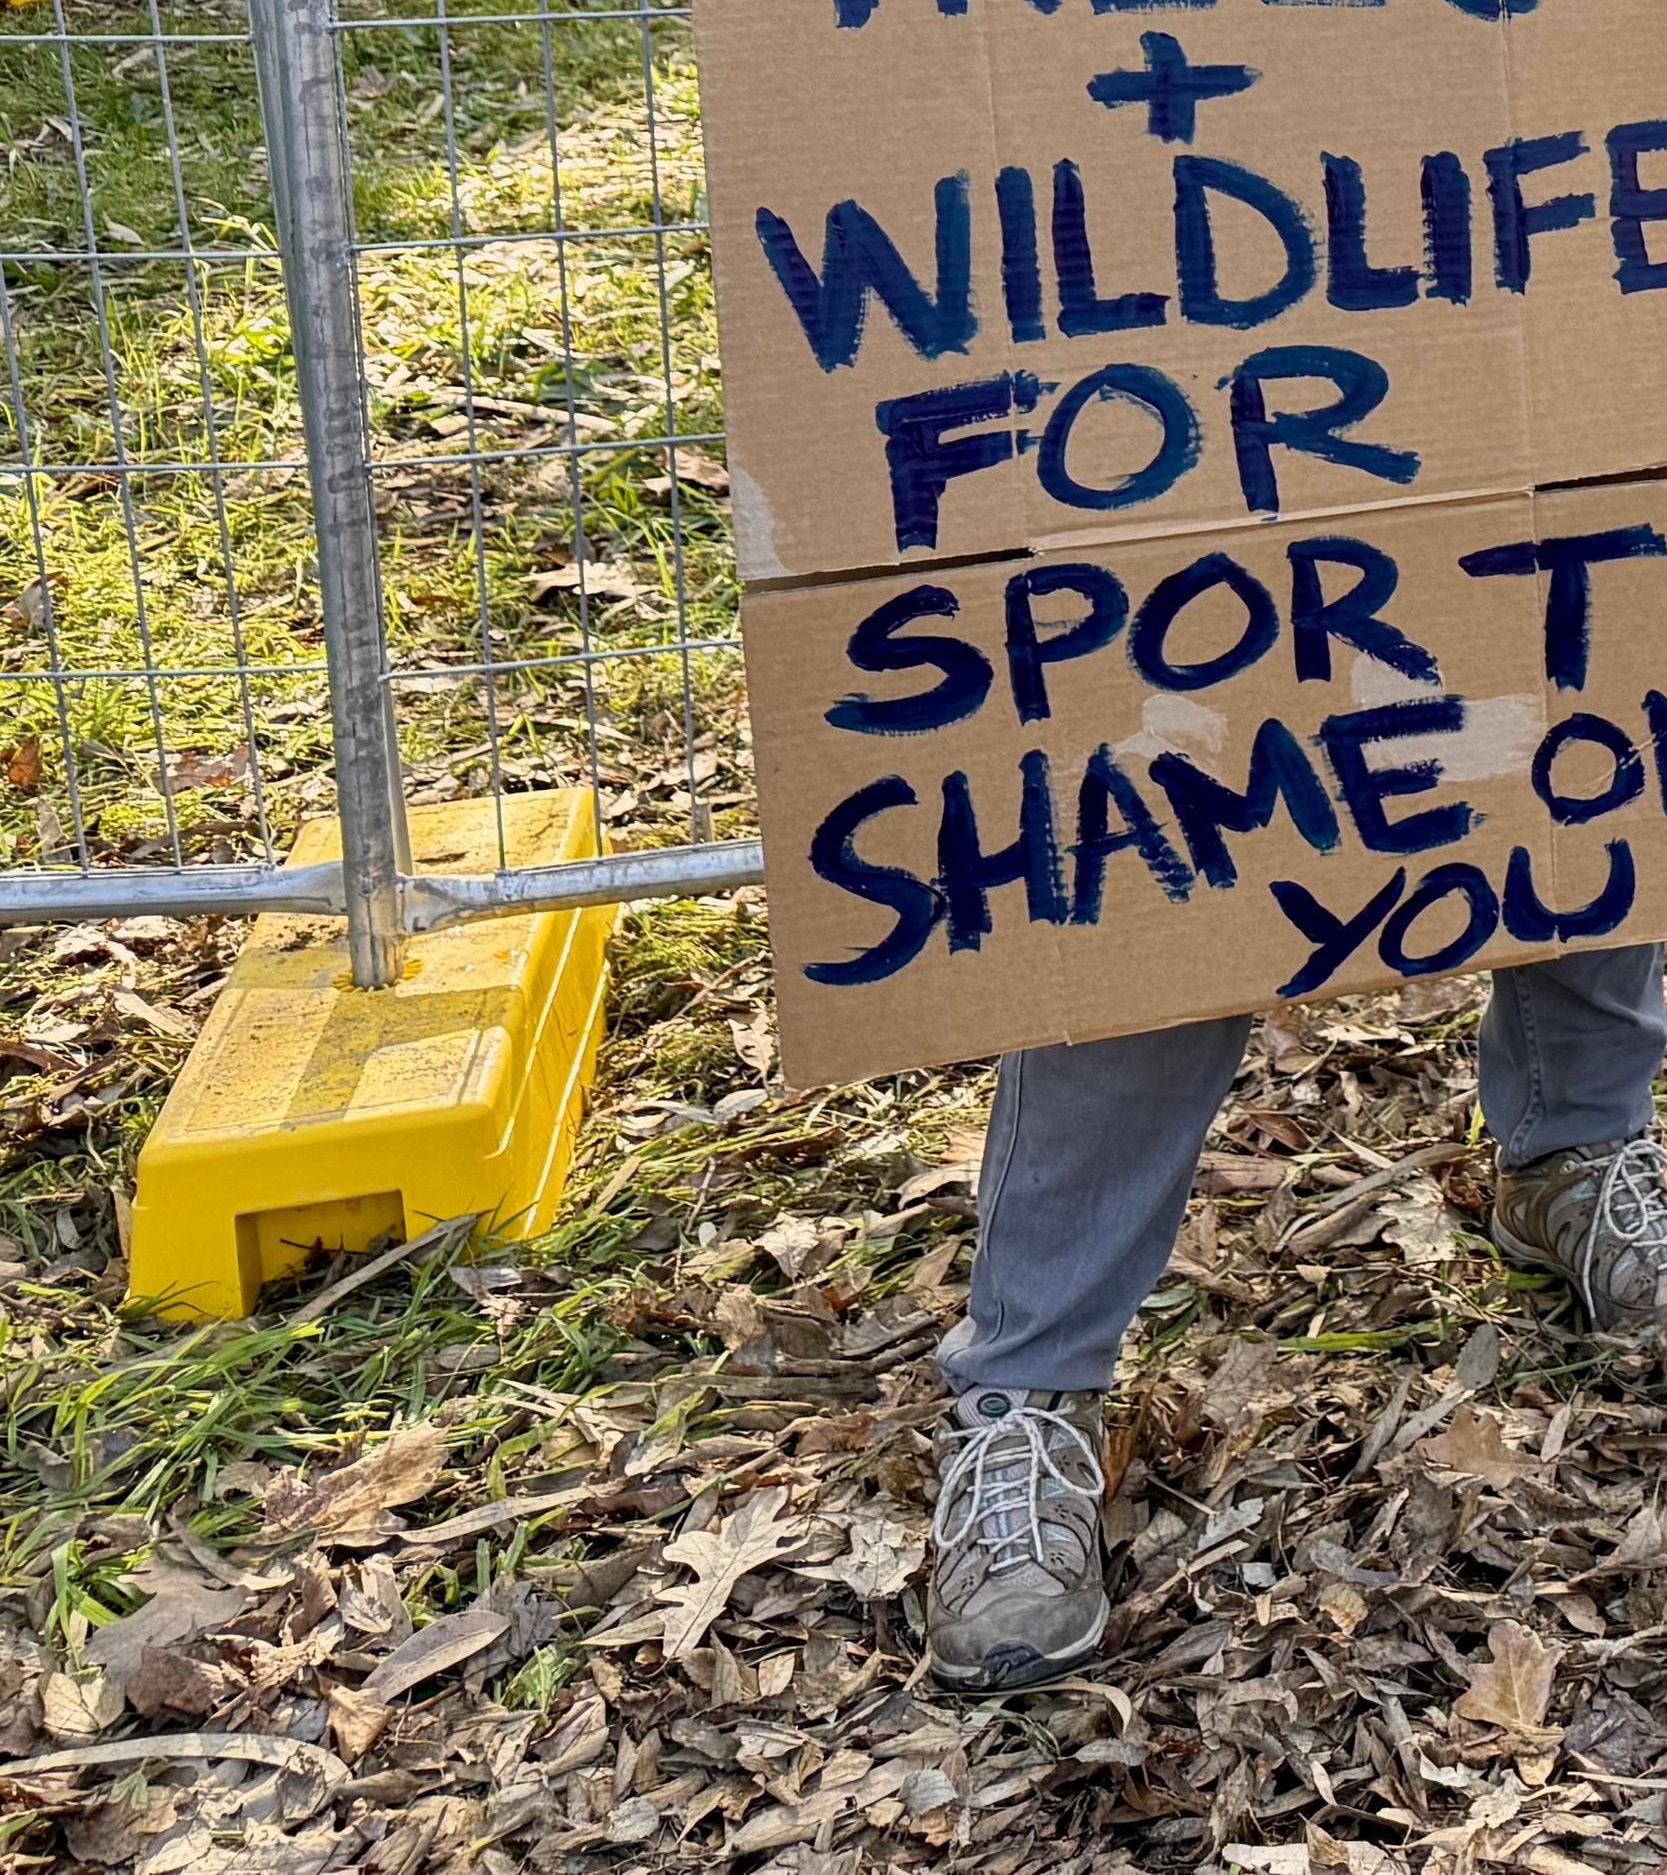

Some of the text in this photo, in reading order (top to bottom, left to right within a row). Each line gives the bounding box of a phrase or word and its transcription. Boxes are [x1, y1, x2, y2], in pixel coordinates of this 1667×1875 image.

[1087, 32, 1263, 144] +
[876, 346, 1420, 551] FOR
[804, 695, 1487, 986] SHAME
[1270, 838, 1633, 999] YOU
